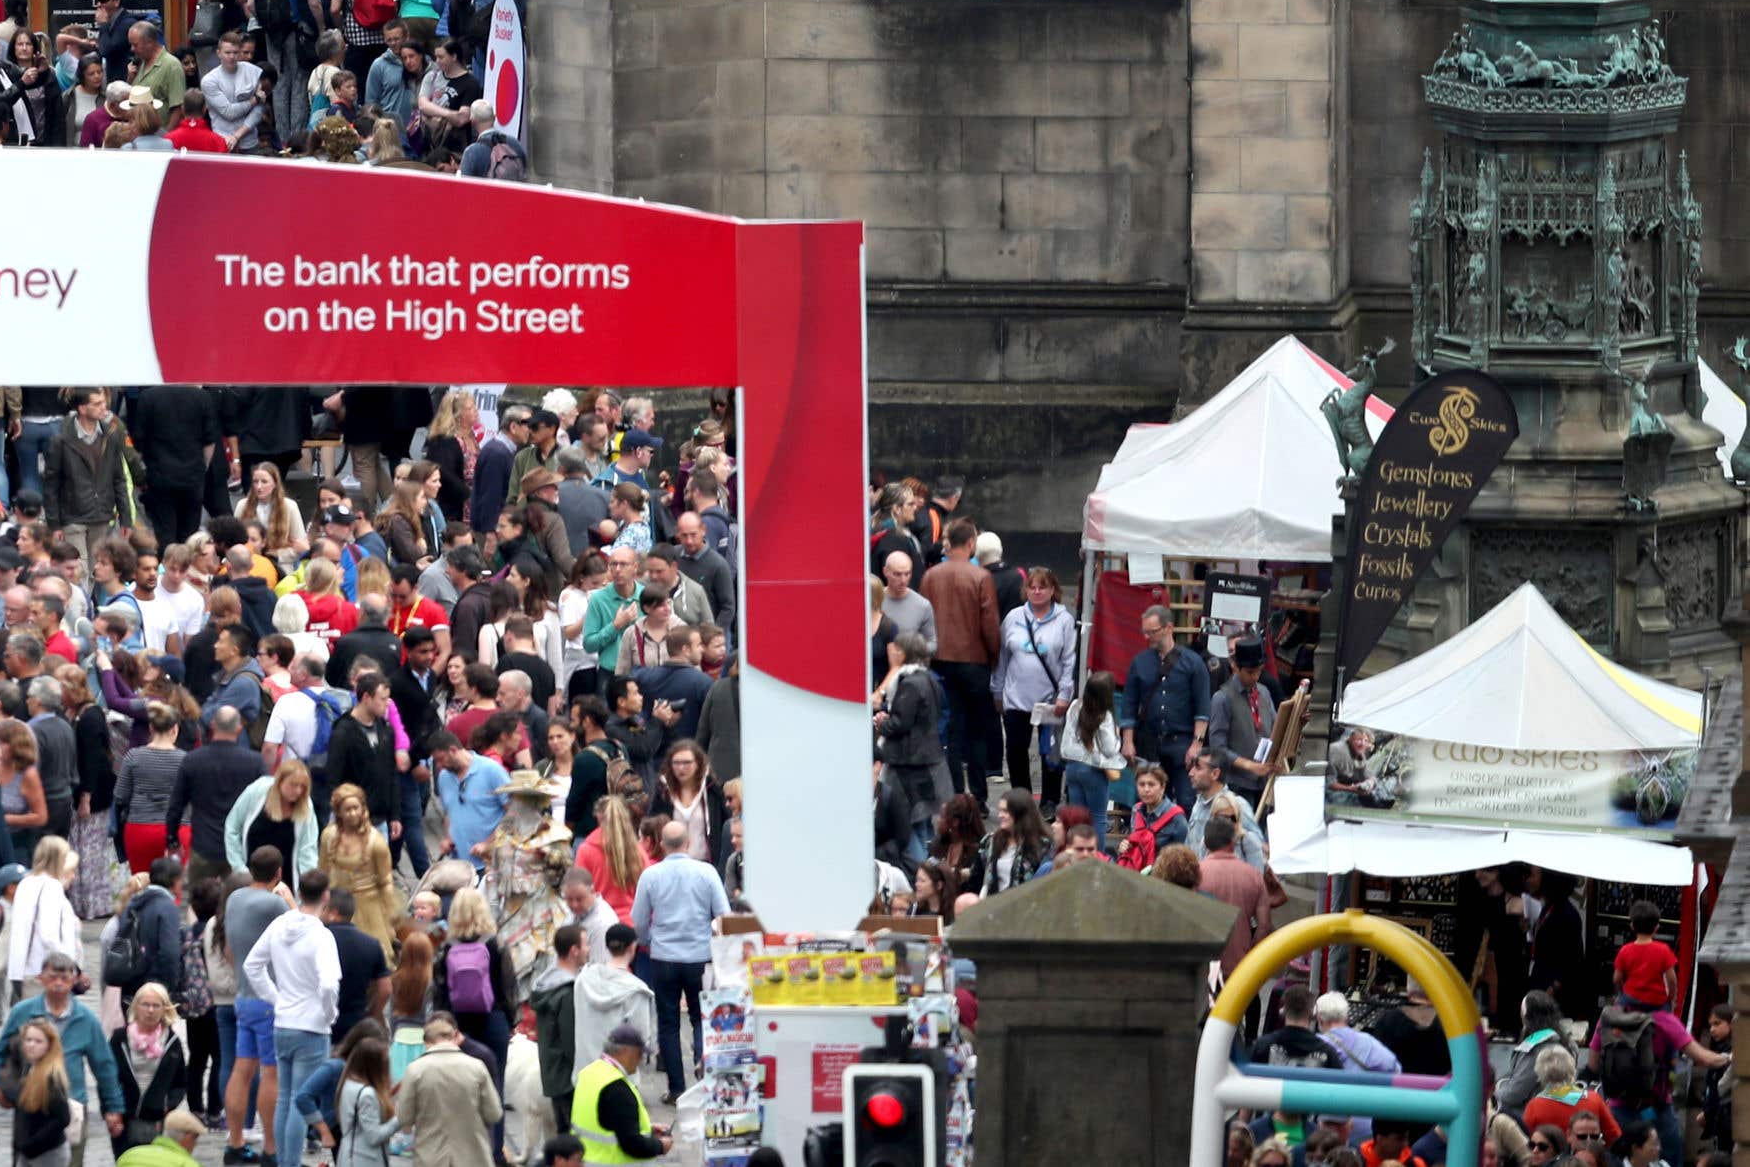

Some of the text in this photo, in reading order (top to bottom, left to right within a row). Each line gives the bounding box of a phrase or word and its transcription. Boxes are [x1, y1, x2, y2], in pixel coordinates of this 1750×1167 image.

[215, 254, 631, 295] The bank that performs
[263, 299, 585, 341] on the High Street
[1409, 411, 1507, 433] Two Skies
[1379, 461, 1473, 489] Gemstones
[1371, 489, 1454, 522] Jewellery
[1364, 521, 1433, 550] Crystals
[1359, 552, 1414, 581] Fossils
[1354, 583, 1402, 602] Curios
